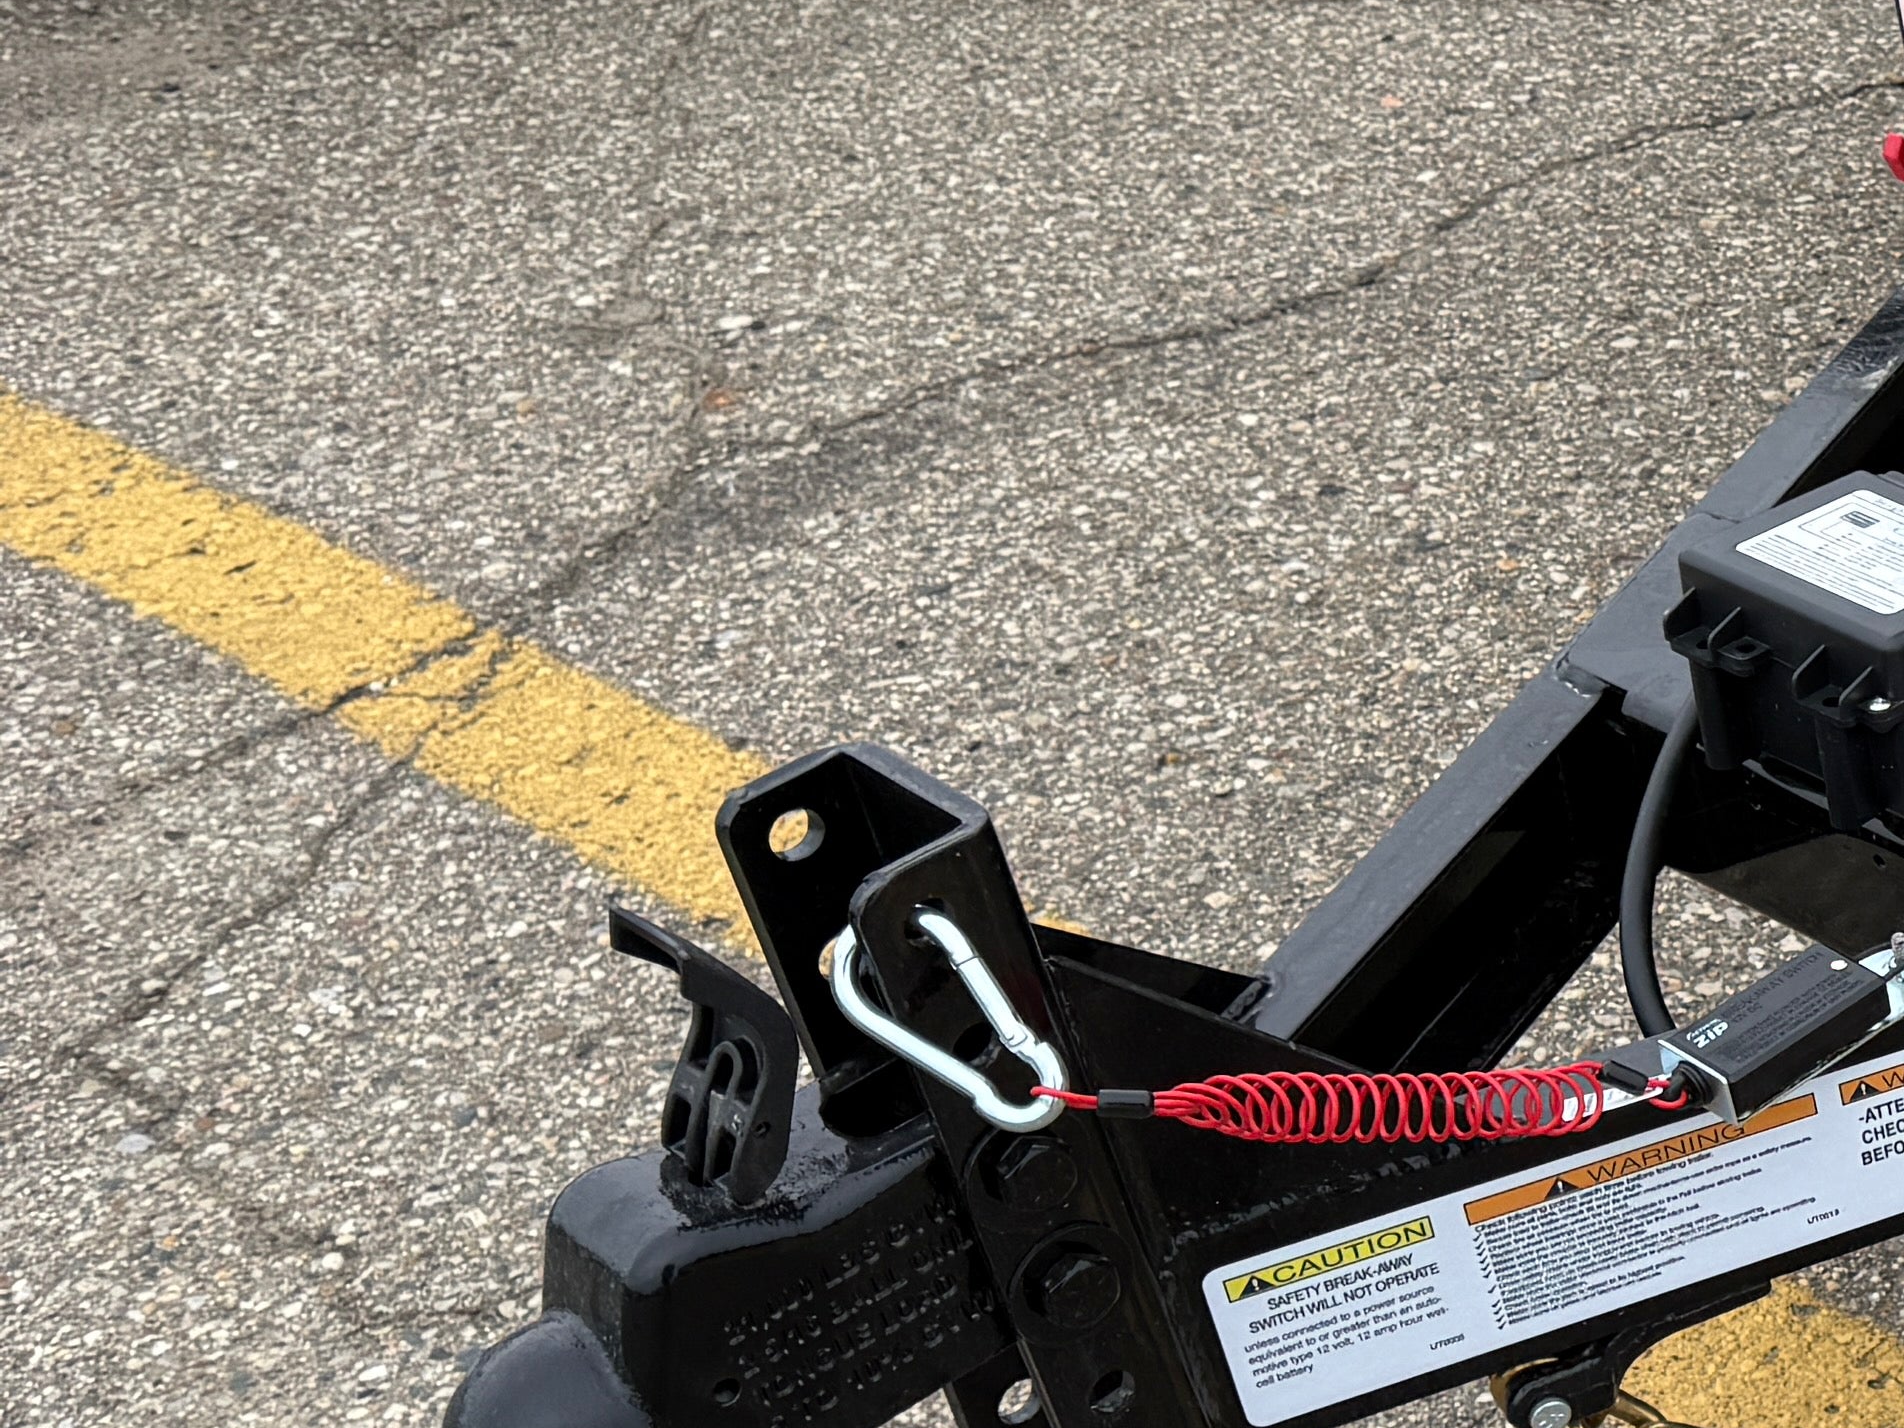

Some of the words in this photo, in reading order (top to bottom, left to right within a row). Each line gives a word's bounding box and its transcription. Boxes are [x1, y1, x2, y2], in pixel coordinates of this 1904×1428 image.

[1588, 1123, 1745, 1183] WARNING
[1267, 1282, 1320, 1310] SAFETY
[1323, 1252, 1412, 1292] BREAK-AWAY
[1272, 1221, 1426, 1282] CAUTION
[1244, 1336, 1280, 1352] unless
[1281, 1315, 1337, 1340] connected
[1339, 1312, 1350, 1321] to
[1353, 1309, 1361, 1317] a
[1362, 1297, 1395, 1315] power
[1398, 1285, 1434, 1302] source
[1248, 1305, 1305, 1333] SWITCH
[1305, 1295, 1342, 1314] WILL
[1343, 1283, 1371, 1302] NOT
[1375, 1262, 1439, 1292] OPERATE
[1248, 1340, 1303, 1364] equivalent
[1304, 1337, 1316, 1345] to
[1318, 1332, 1329, 1341] or
[1332, 1318, 1369, 1339] greater
[1372, 1310, 1397, 1324] than
[1399, 1305, 1413, 1315] an
[1252, 1359, 1287, 1376] motive
[1289, 1351, 1313, 1364] type
[1316, 1344, 1329, 1354] 12
[1357, 1330, 1370, 1341] 12
[1373, 1323, 1396, 1336] amp
[1399, 1314, 1422, 1327] hour
[1255, 1375, 1274, 1388] cell
[1275, 1363, 1313, 1381] battery
